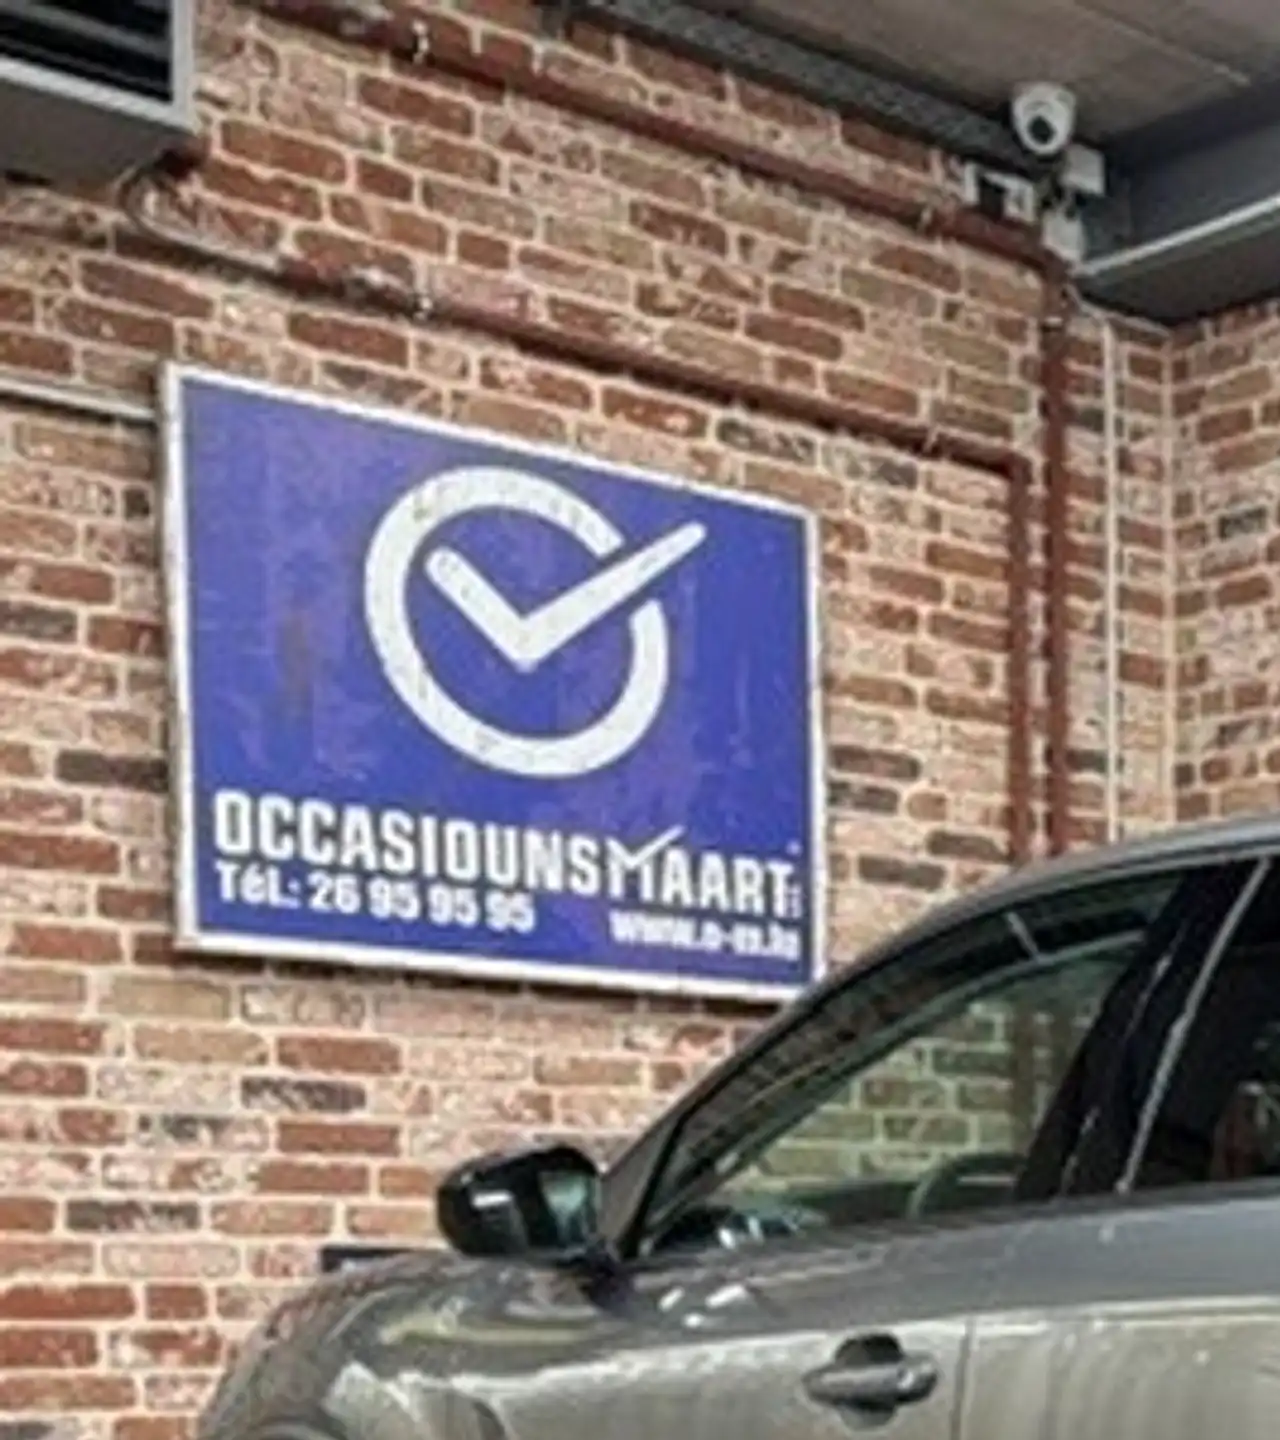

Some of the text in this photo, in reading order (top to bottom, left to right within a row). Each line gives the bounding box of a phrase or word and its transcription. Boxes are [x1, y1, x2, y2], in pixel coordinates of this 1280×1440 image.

[213, 787, 795, 919] OCCASIOUNSMAART
[306, 869, 361, 915] 26
[367, 876, 420, 921] 95
[426, 883, 479, 928] 95
[484, 888, 537, 934] 95
